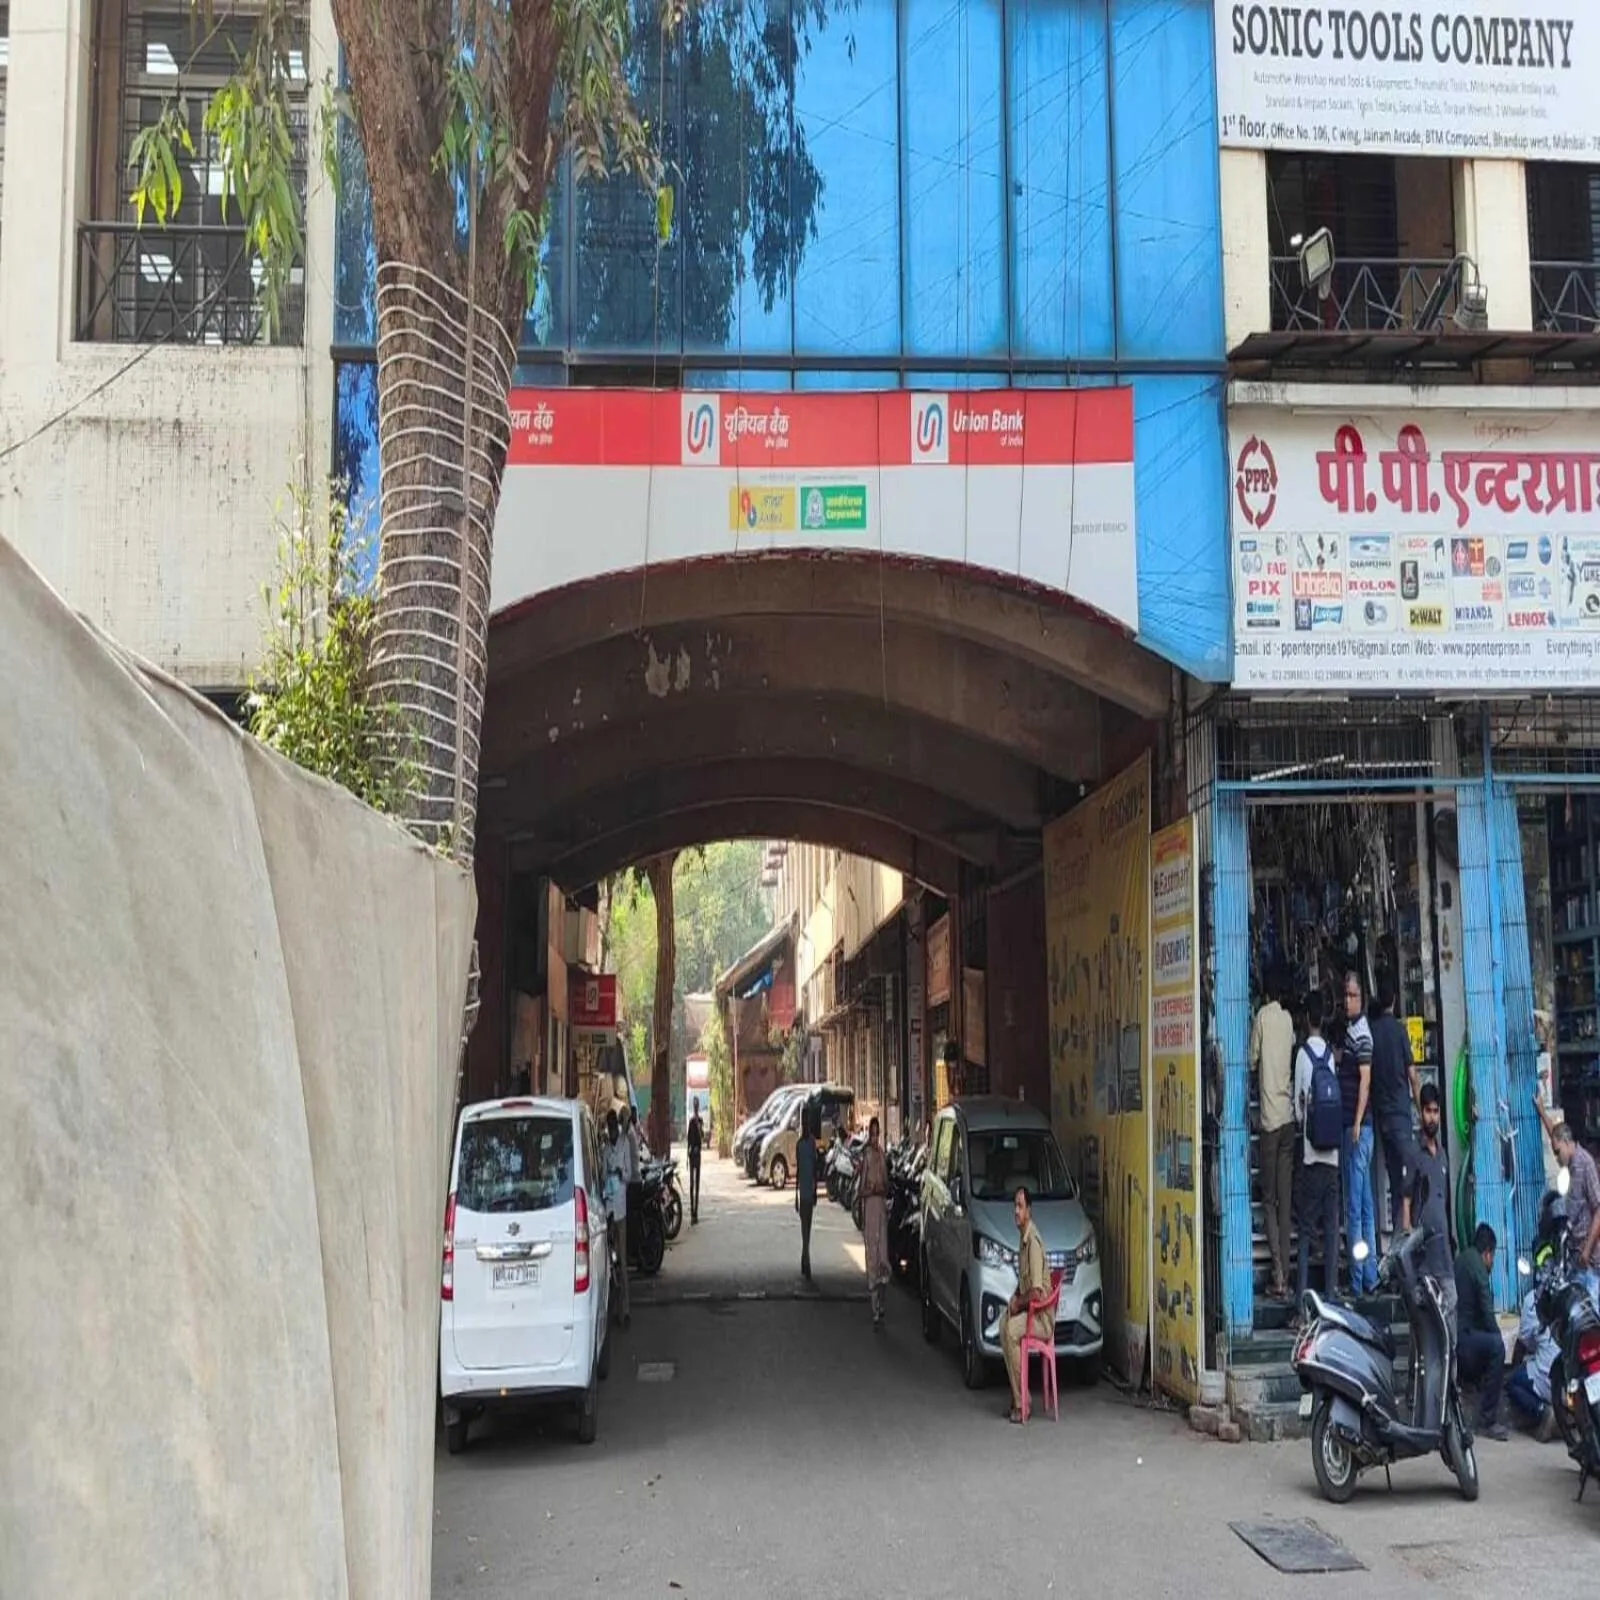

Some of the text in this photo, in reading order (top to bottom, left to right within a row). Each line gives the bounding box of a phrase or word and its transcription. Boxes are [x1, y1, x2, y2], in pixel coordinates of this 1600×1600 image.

[1232, 4, 1574, 68] SONIC TOOLS COMPANY
[1222, 114, 1236, 136] 1st
[1239, 114, 1269, 140] floor,
[1271, 123, 1295, 140] Office
[1297, 125, 1310, 140] No.
[1332, 127, 1337, 141] C
[1340, 128, 1361, 146] wing,
[1363, 128, 1392, 143] Jainam
[1394, 129, 1424, 147] Arcade,
[1425, 129, 1443, 144] BTM
[1445, 130, 1492, 150] Compound,
[1493, 132, 1528, 150] Bhandup
[725, 406, 767, 442] यूनियन
[953, 408, 1023, 432] Union Bank
[1245, 468, 1270, 493] PPE
[1267, 561, 1286, 576] FAG
[1248, 580, 1280, 596] PIX
[1348, 580, 1396, 591] ROLON
[1455, 606, 1493, 621] MIRANDA
[1508, 612, 1546, 628] LENOX
[1443, 639, 1531, 660] www.ppenterprise.in
[1546, 639, 1593, 659] Everything
